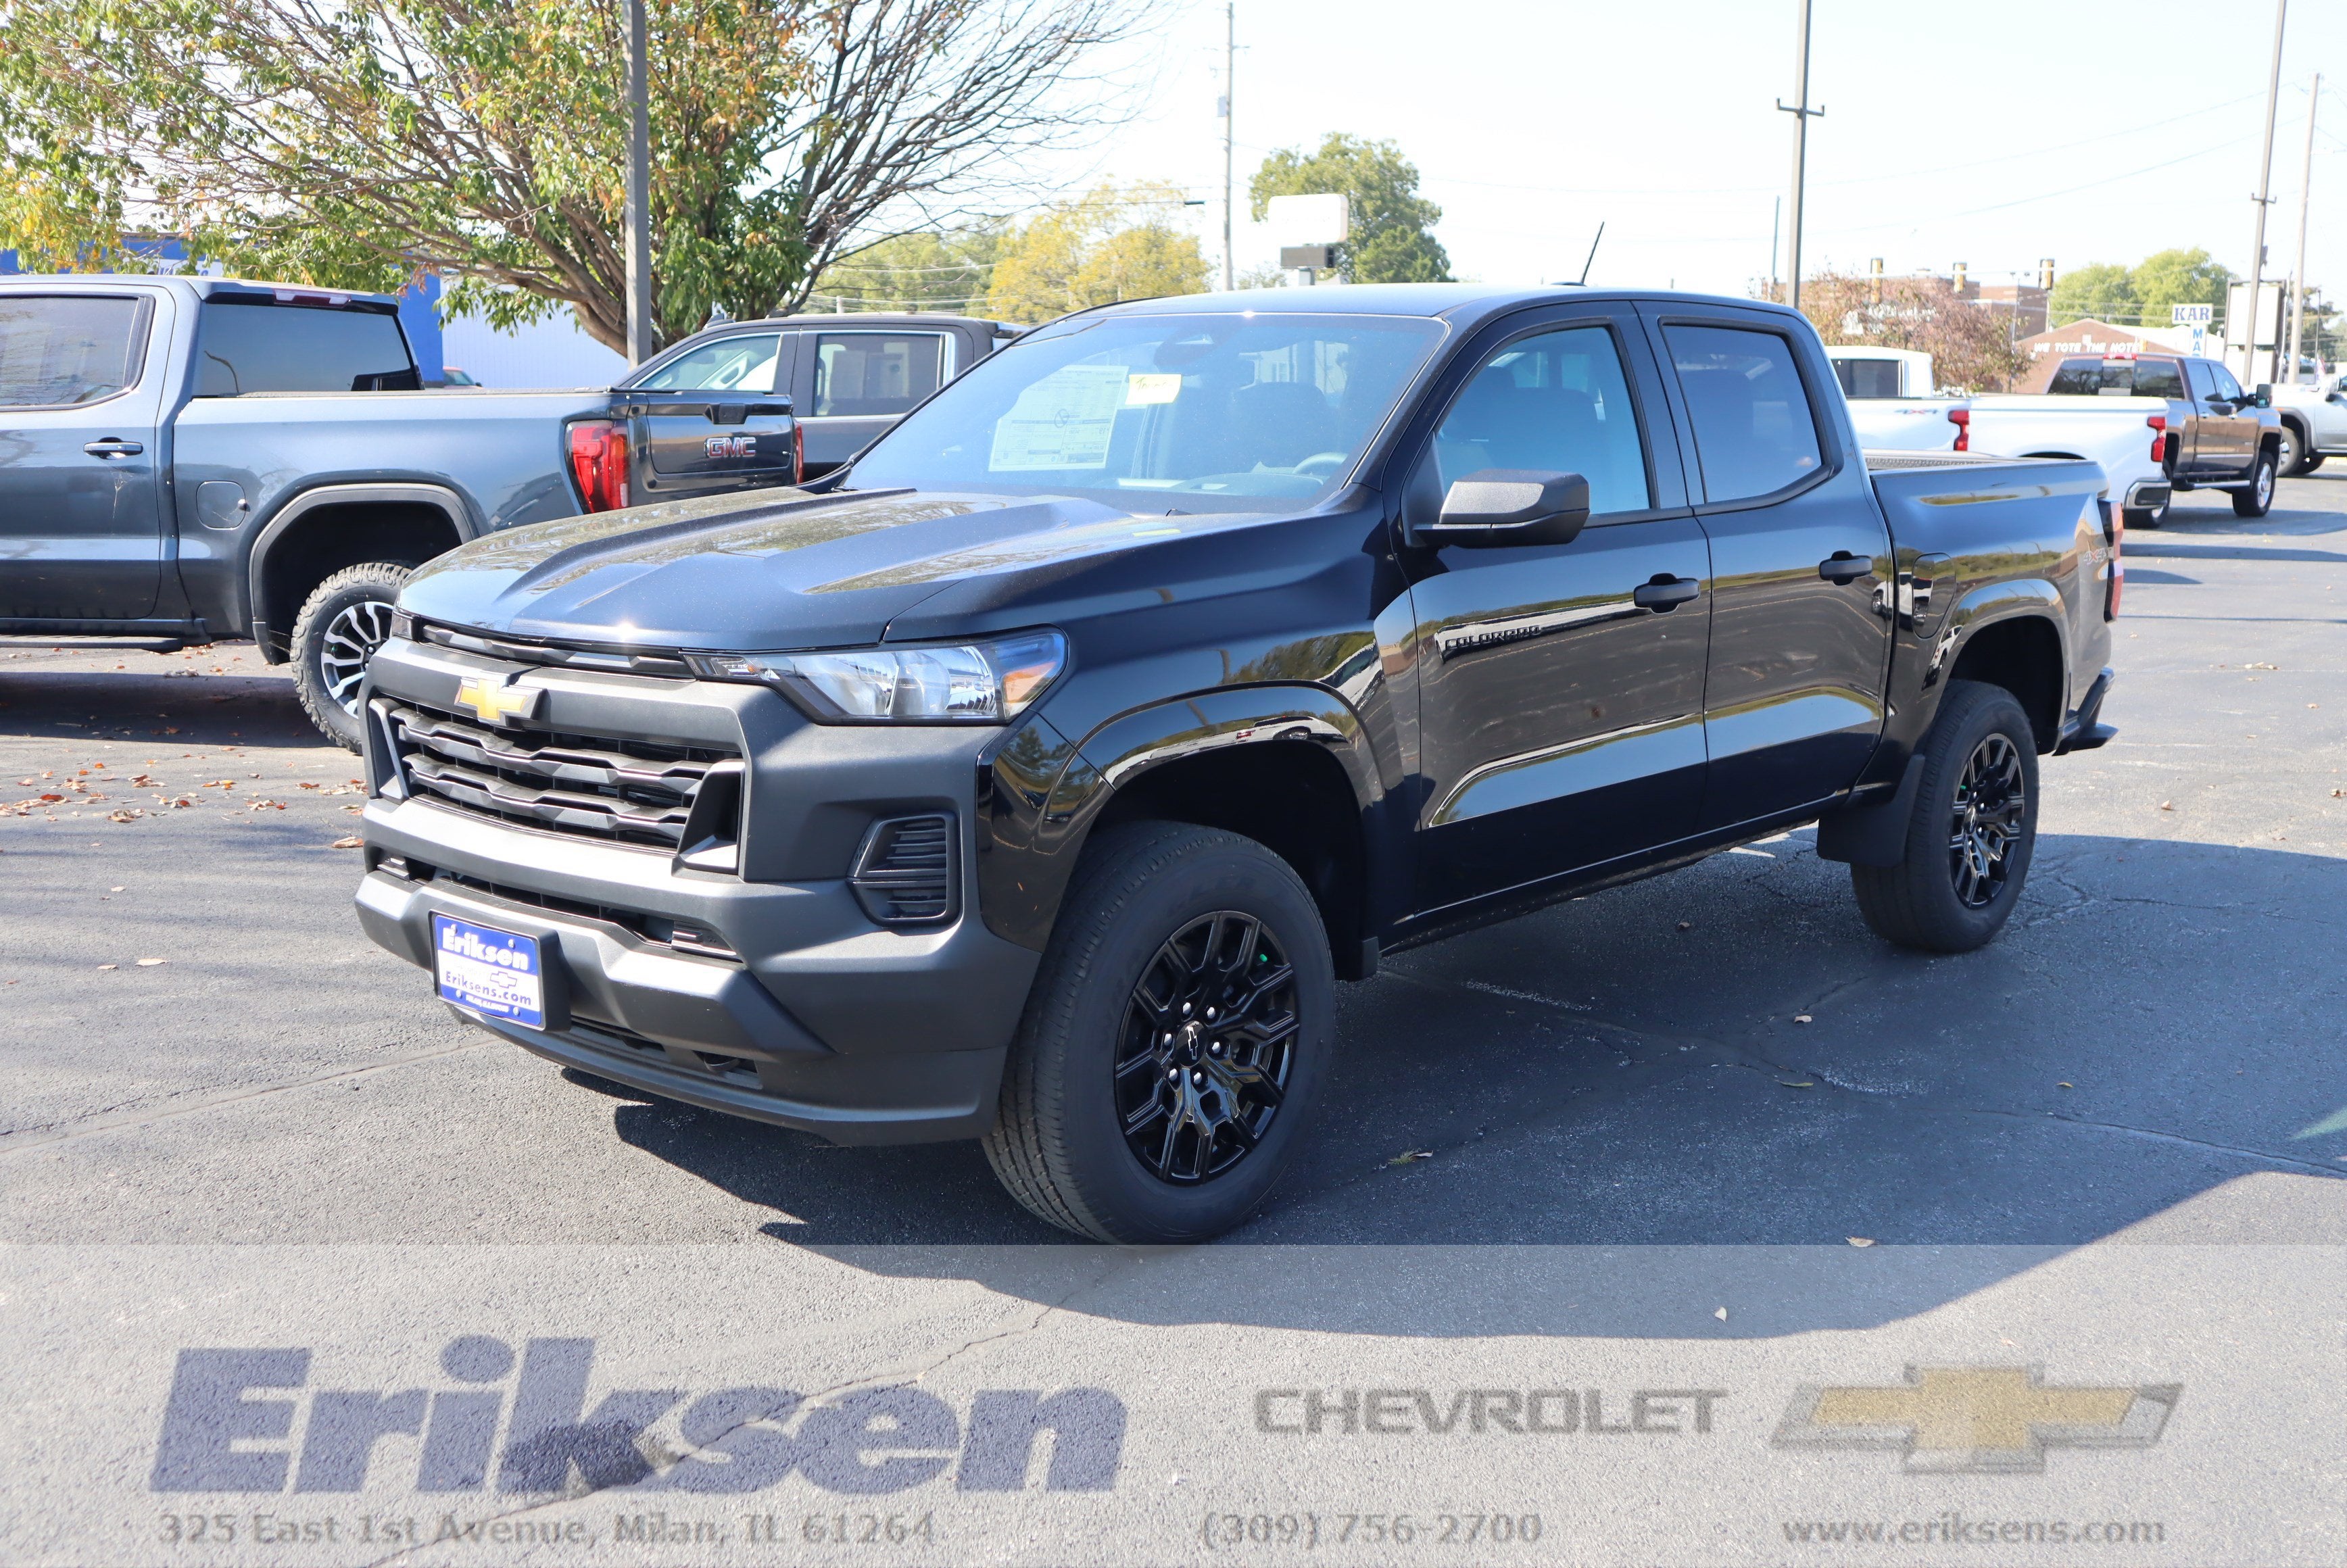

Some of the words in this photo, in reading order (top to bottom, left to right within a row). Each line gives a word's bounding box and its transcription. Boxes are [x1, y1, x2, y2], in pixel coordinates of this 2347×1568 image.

[2174, 307, 2210, 321] KAR
[2035, 342, 2050, 353] WE
[2055, 342, 2082, 353] TOTE
[2087, 342, 2106, 353] THE
[704, 437, 756, 458] GMC
[1445, 624, 1541, 651] COLORADO
[442, 927, 529, 971] Eriksen
[445, 971, 532, 1006] Eriksens.com
